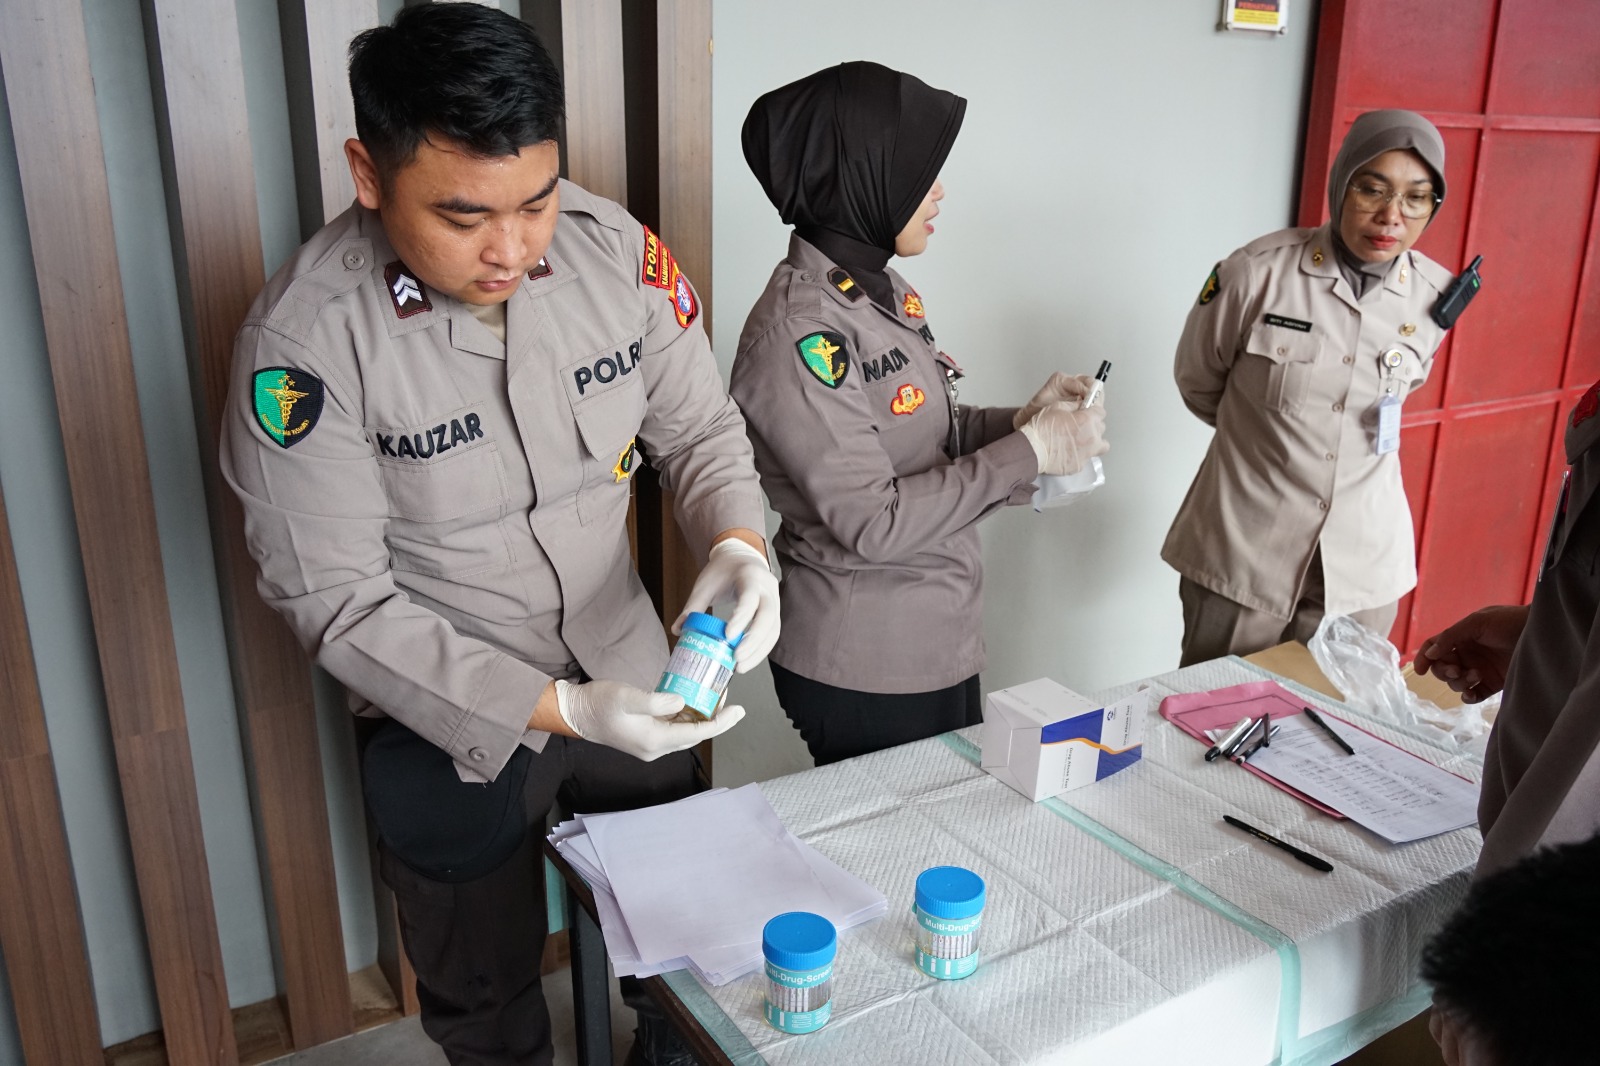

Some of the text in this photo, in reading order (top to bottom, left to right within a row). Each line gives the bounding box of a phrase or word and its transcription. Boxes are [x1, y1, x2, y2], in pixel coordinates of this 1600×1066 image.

[574, 336, 643, 396] POLRI
[862, 346, 910, 383] NADI
[376, 412, 484, 460] KAUZAR
